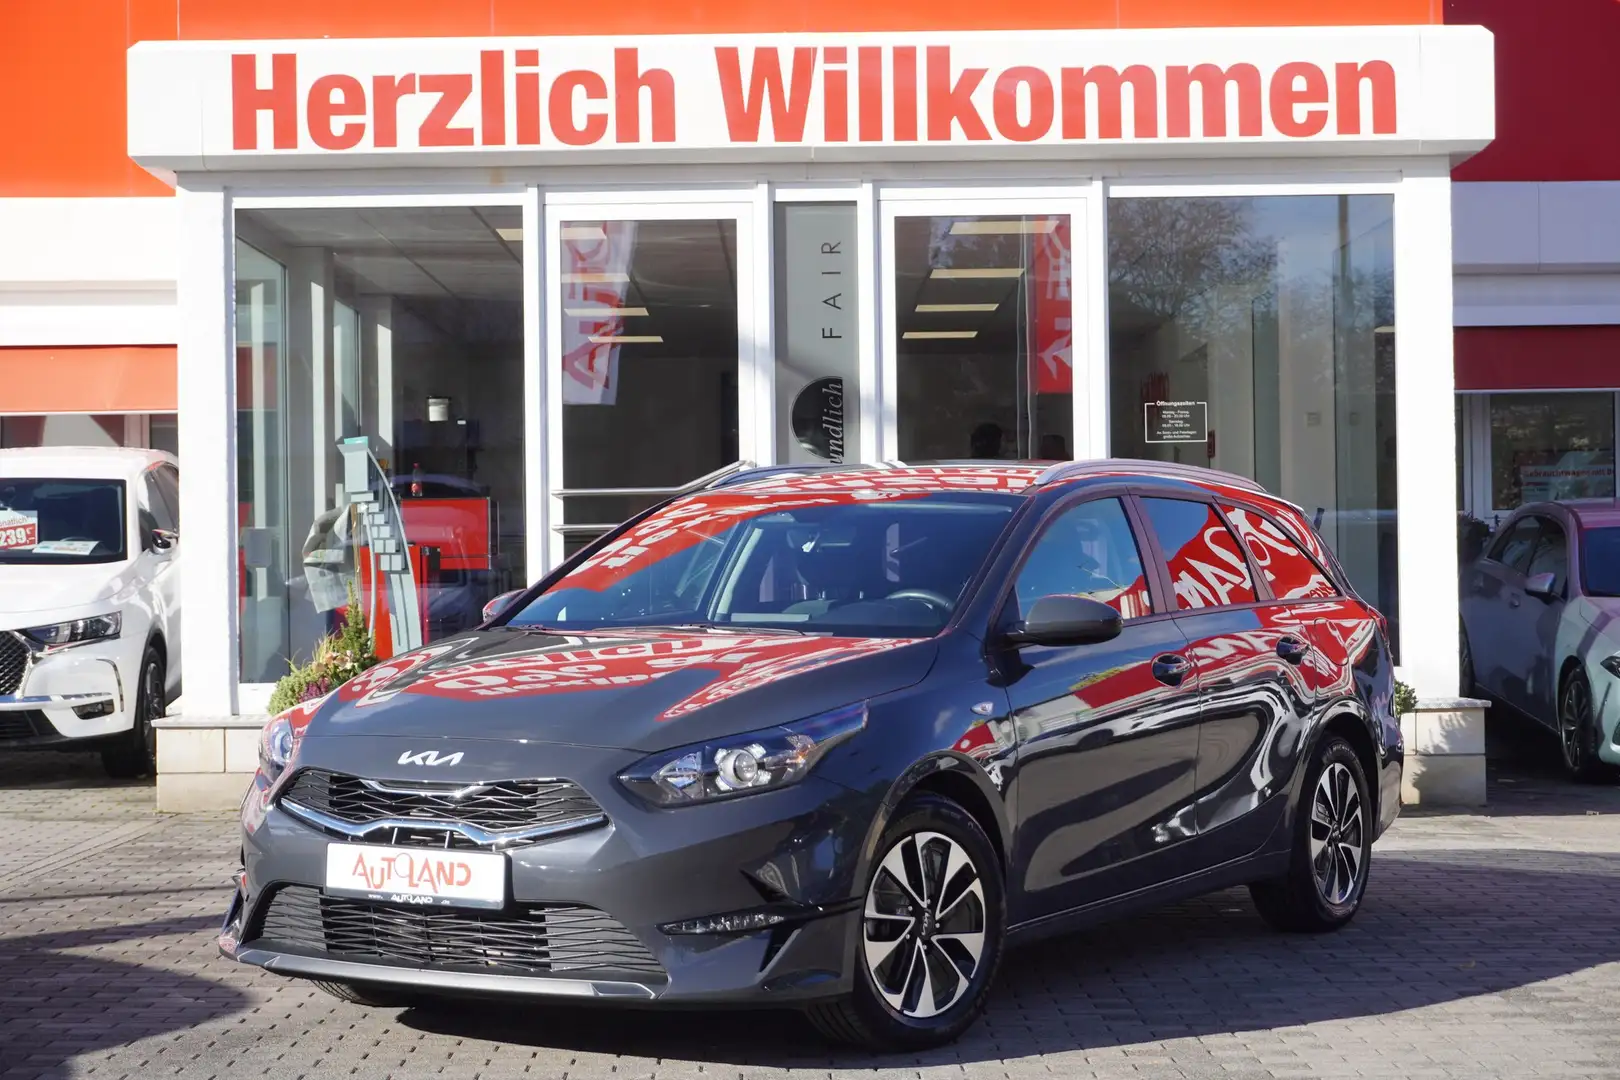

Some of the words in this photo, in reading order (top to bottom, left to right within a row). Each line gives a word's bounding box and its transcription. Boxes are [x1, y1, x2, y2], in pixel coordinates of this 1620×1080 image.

[231, 47, 676, 150] Herzlich
[714, 44, 1397, 142] Willkommen
[821, 241, 842, 339] FAIR
[352, 851, 472, 894] AUTOLAND
